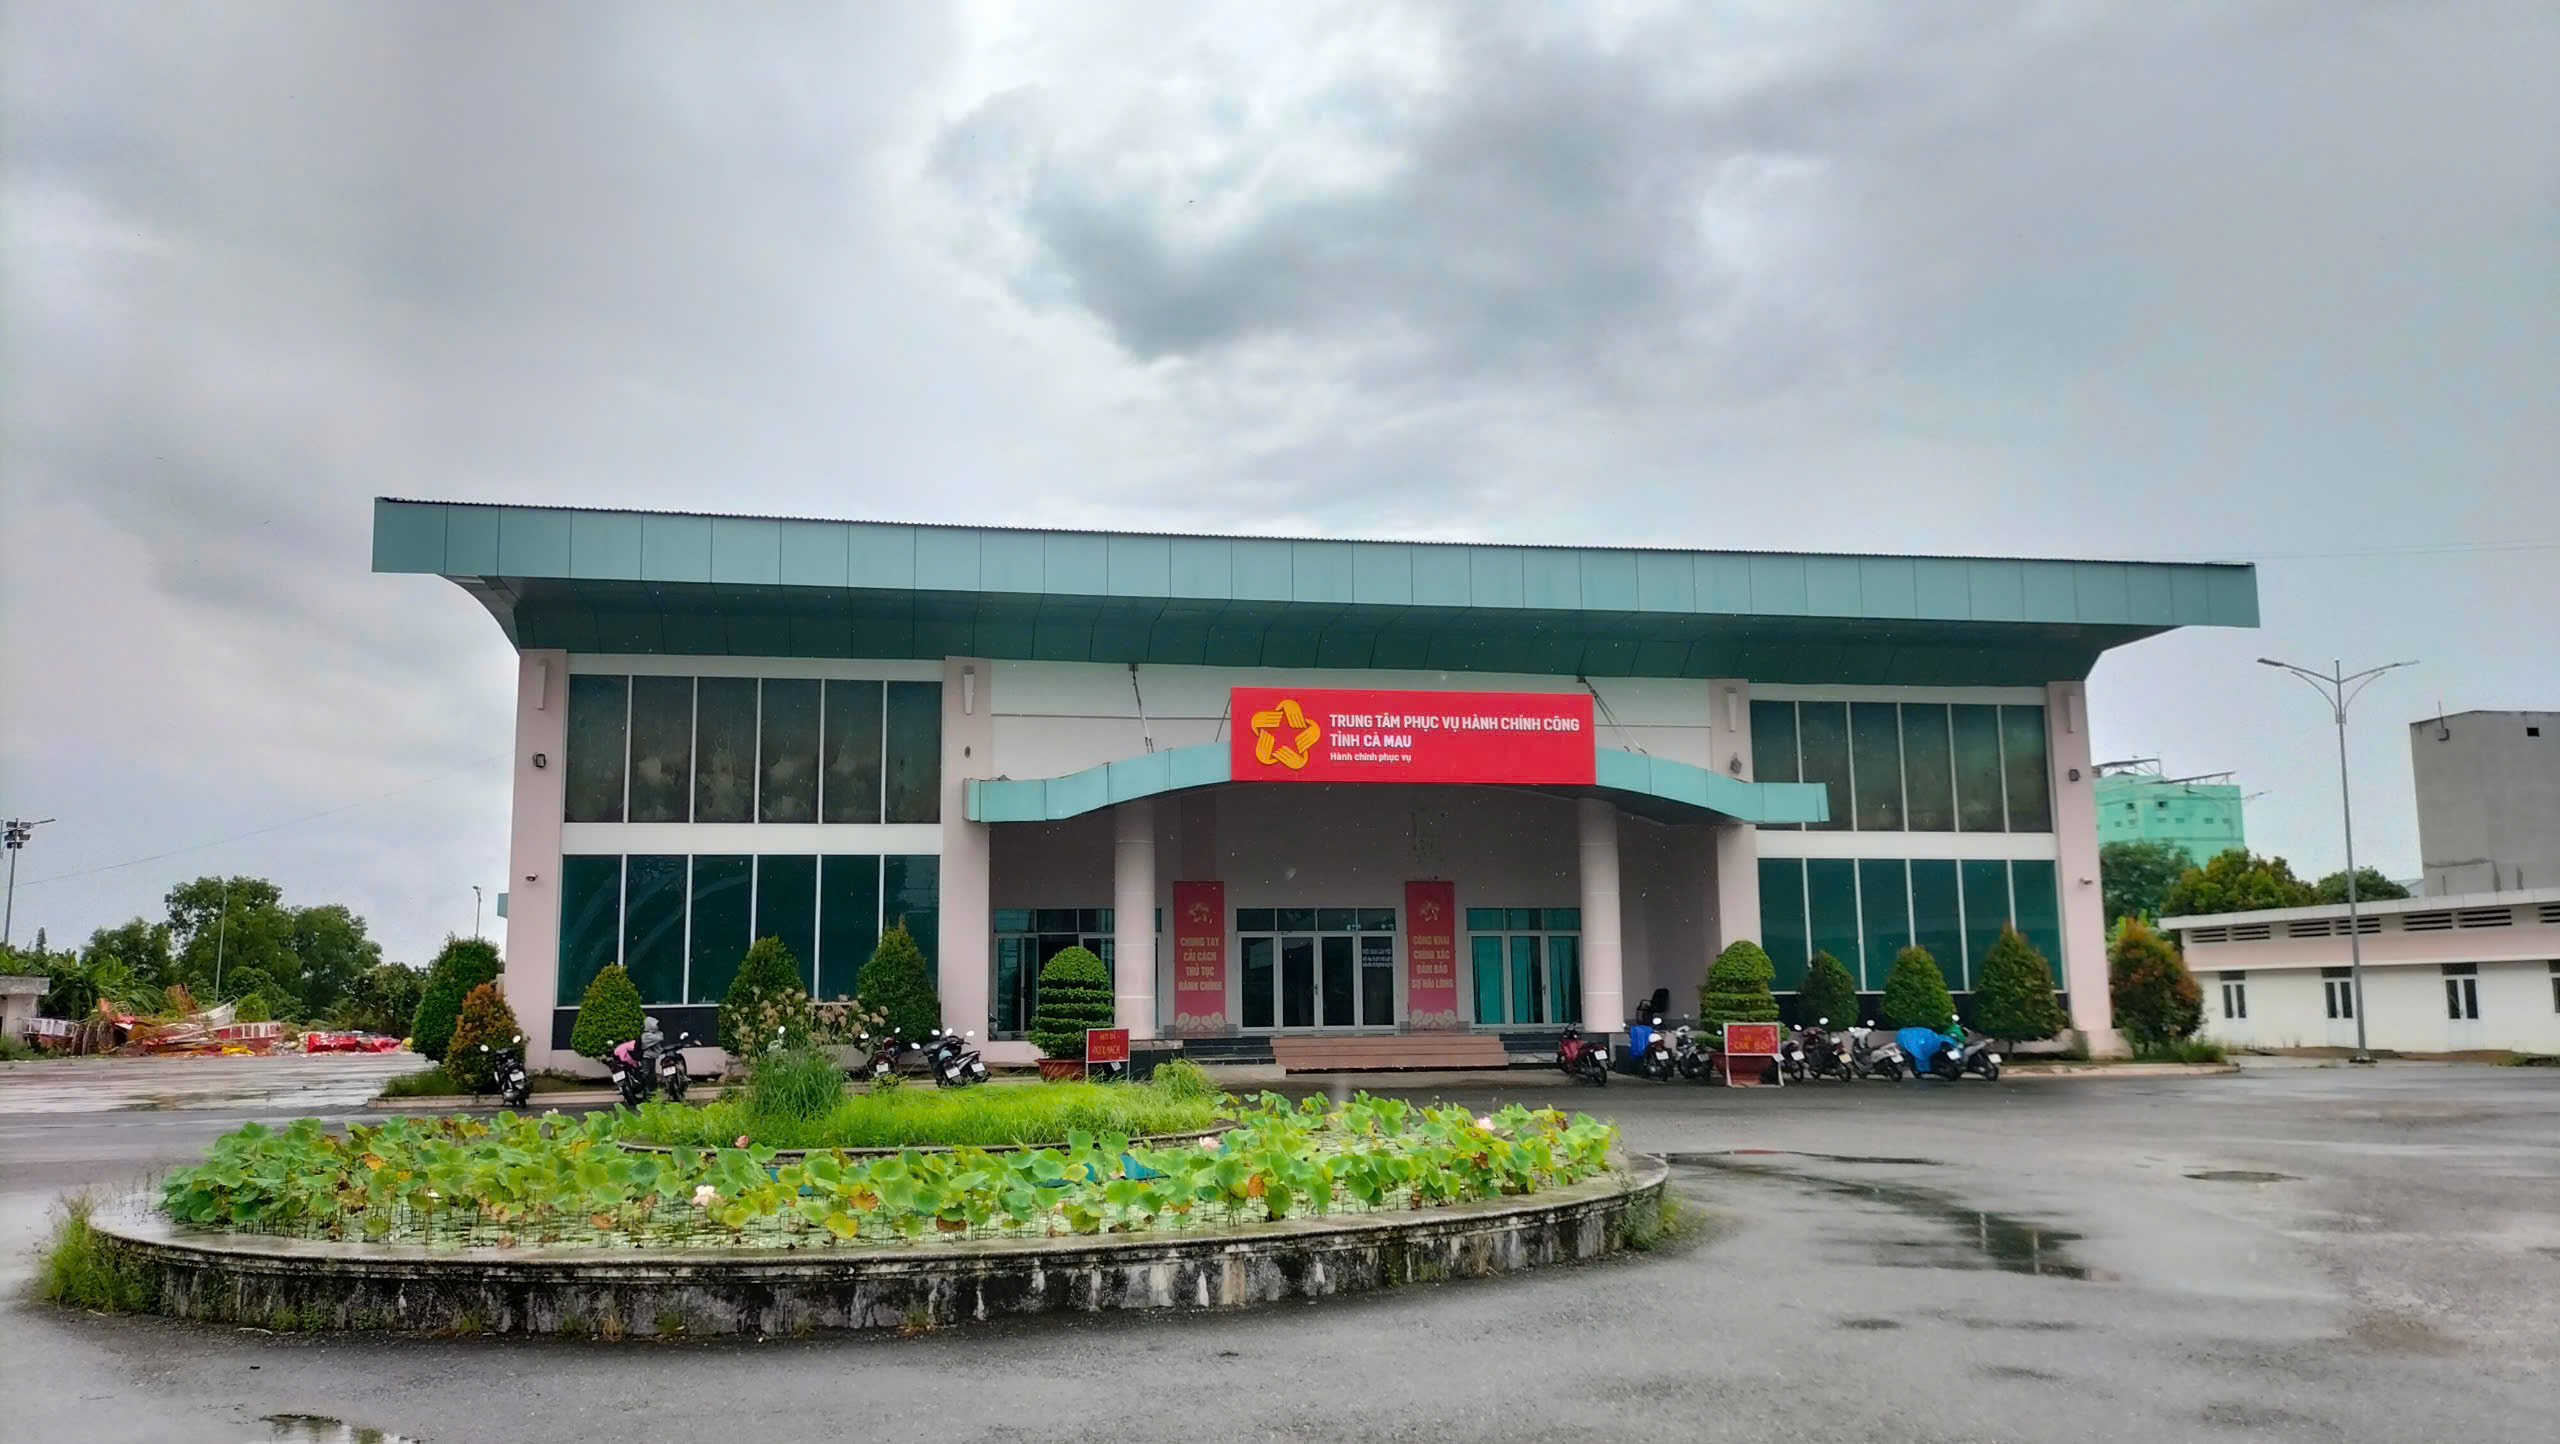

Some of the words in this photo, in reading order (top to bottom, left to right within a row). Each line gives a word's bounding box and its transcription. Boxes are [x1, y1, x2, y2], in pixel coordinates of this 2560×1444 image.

[1330, 714, 1373, 728] TRUNG
[1375, 712, 1401, 729] TÂM
[1403, 715, 1439, 732] PHỤC
[1442, 716, 1459, 732] VỤ
[1462, 714, 1498, 730] HÀNH
[1501, 714, 1541, 731] CHÍNH
[1543, 715, 1580, 731] CÔNG
[1330, 731, 1360, 747] TỈNH
[1363, 731, 1381, 747] CÀ
[1383, 735, 1412, 748] MAU
[1330, 752, 1352, 761] Hành
[1354, 752, 1377, 762] chính
[1378, 753, 1399, 763] phục
[1401, 754, 1412, 763] vụ
[1180, 936, 1205, 946] CHUNG
[1206, 936, 1220, 946] TAY
[1183, 949, 1196, 961] CẢI
[1436, 949, 1451, 960] XÁC
[1186, 963, 1200, 977] THỦ
[1201, 967, 1215, 978] TỤC
